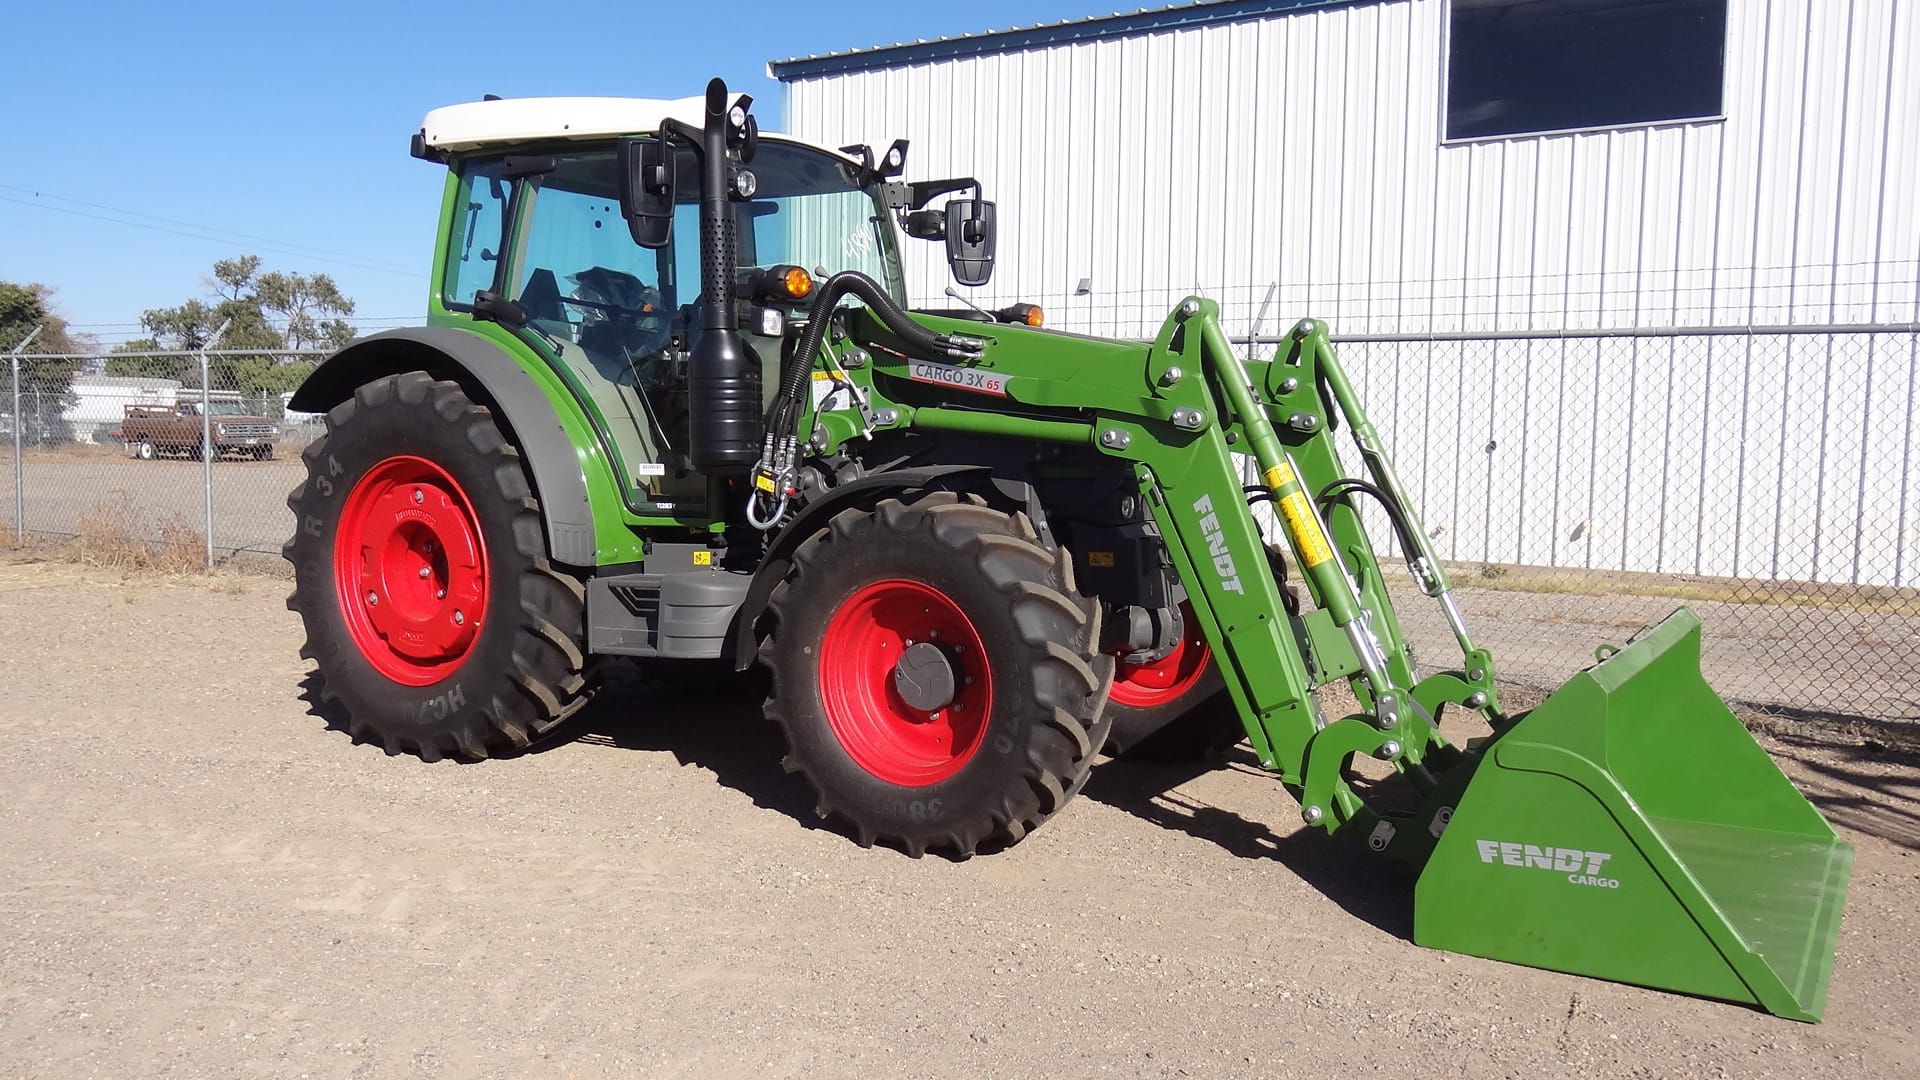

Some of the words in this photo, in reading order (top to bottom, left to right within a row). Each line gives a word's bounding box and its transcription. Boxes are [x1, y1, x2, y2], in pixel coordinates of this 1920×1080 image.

[914, 363, 964, 384] CARGO
[966, 373, 985, 388] 3X
[986, 379, 1000, 390] 65
[304, 514, 323, 537] R
[316, 454, 344, 496] 34
[1193, 493, 1245, 595] FENDT
[1476, 839, 1612, 875] FENDT
[1568, 874, 1620, 889] CARGO
